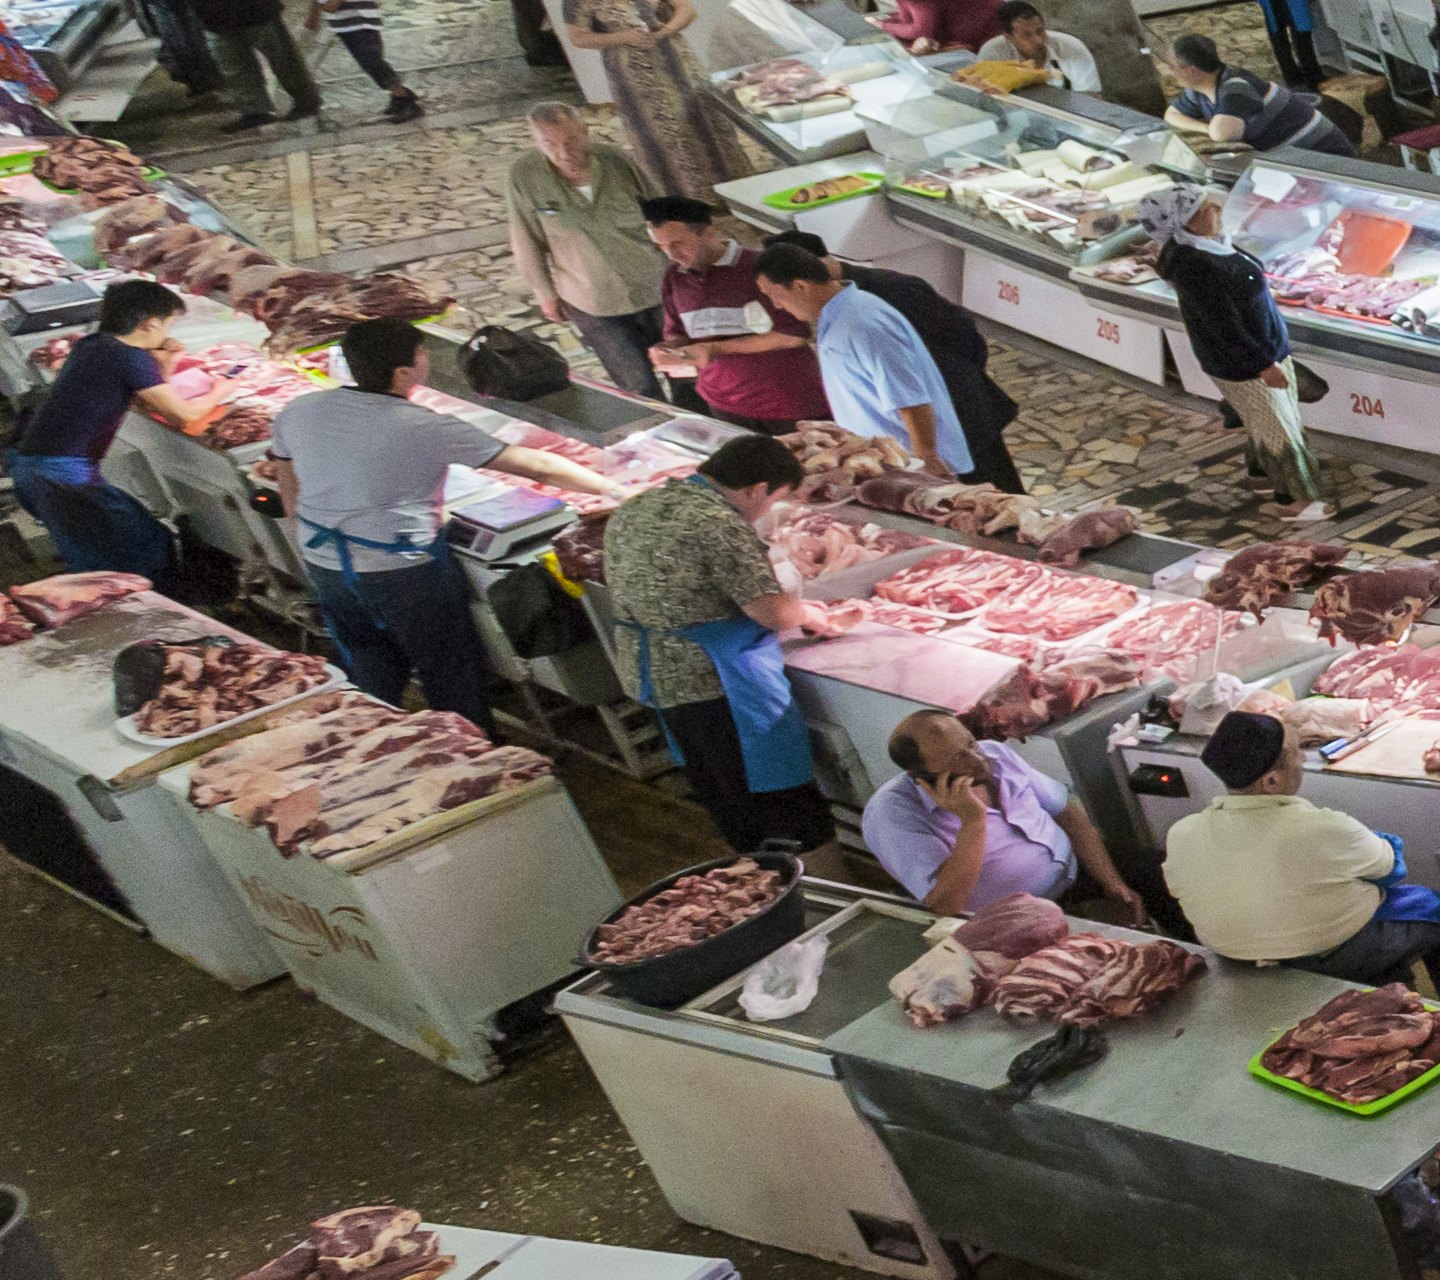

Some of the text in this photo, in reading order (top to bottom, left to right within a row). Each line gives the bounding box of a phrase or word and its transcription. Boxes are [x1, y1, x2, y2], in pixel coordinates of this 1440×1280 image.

[997, 280, 1020, 305] 206
[1096, 317, 1121, 343] 205
[1349, 393, 1386, 420] 204
